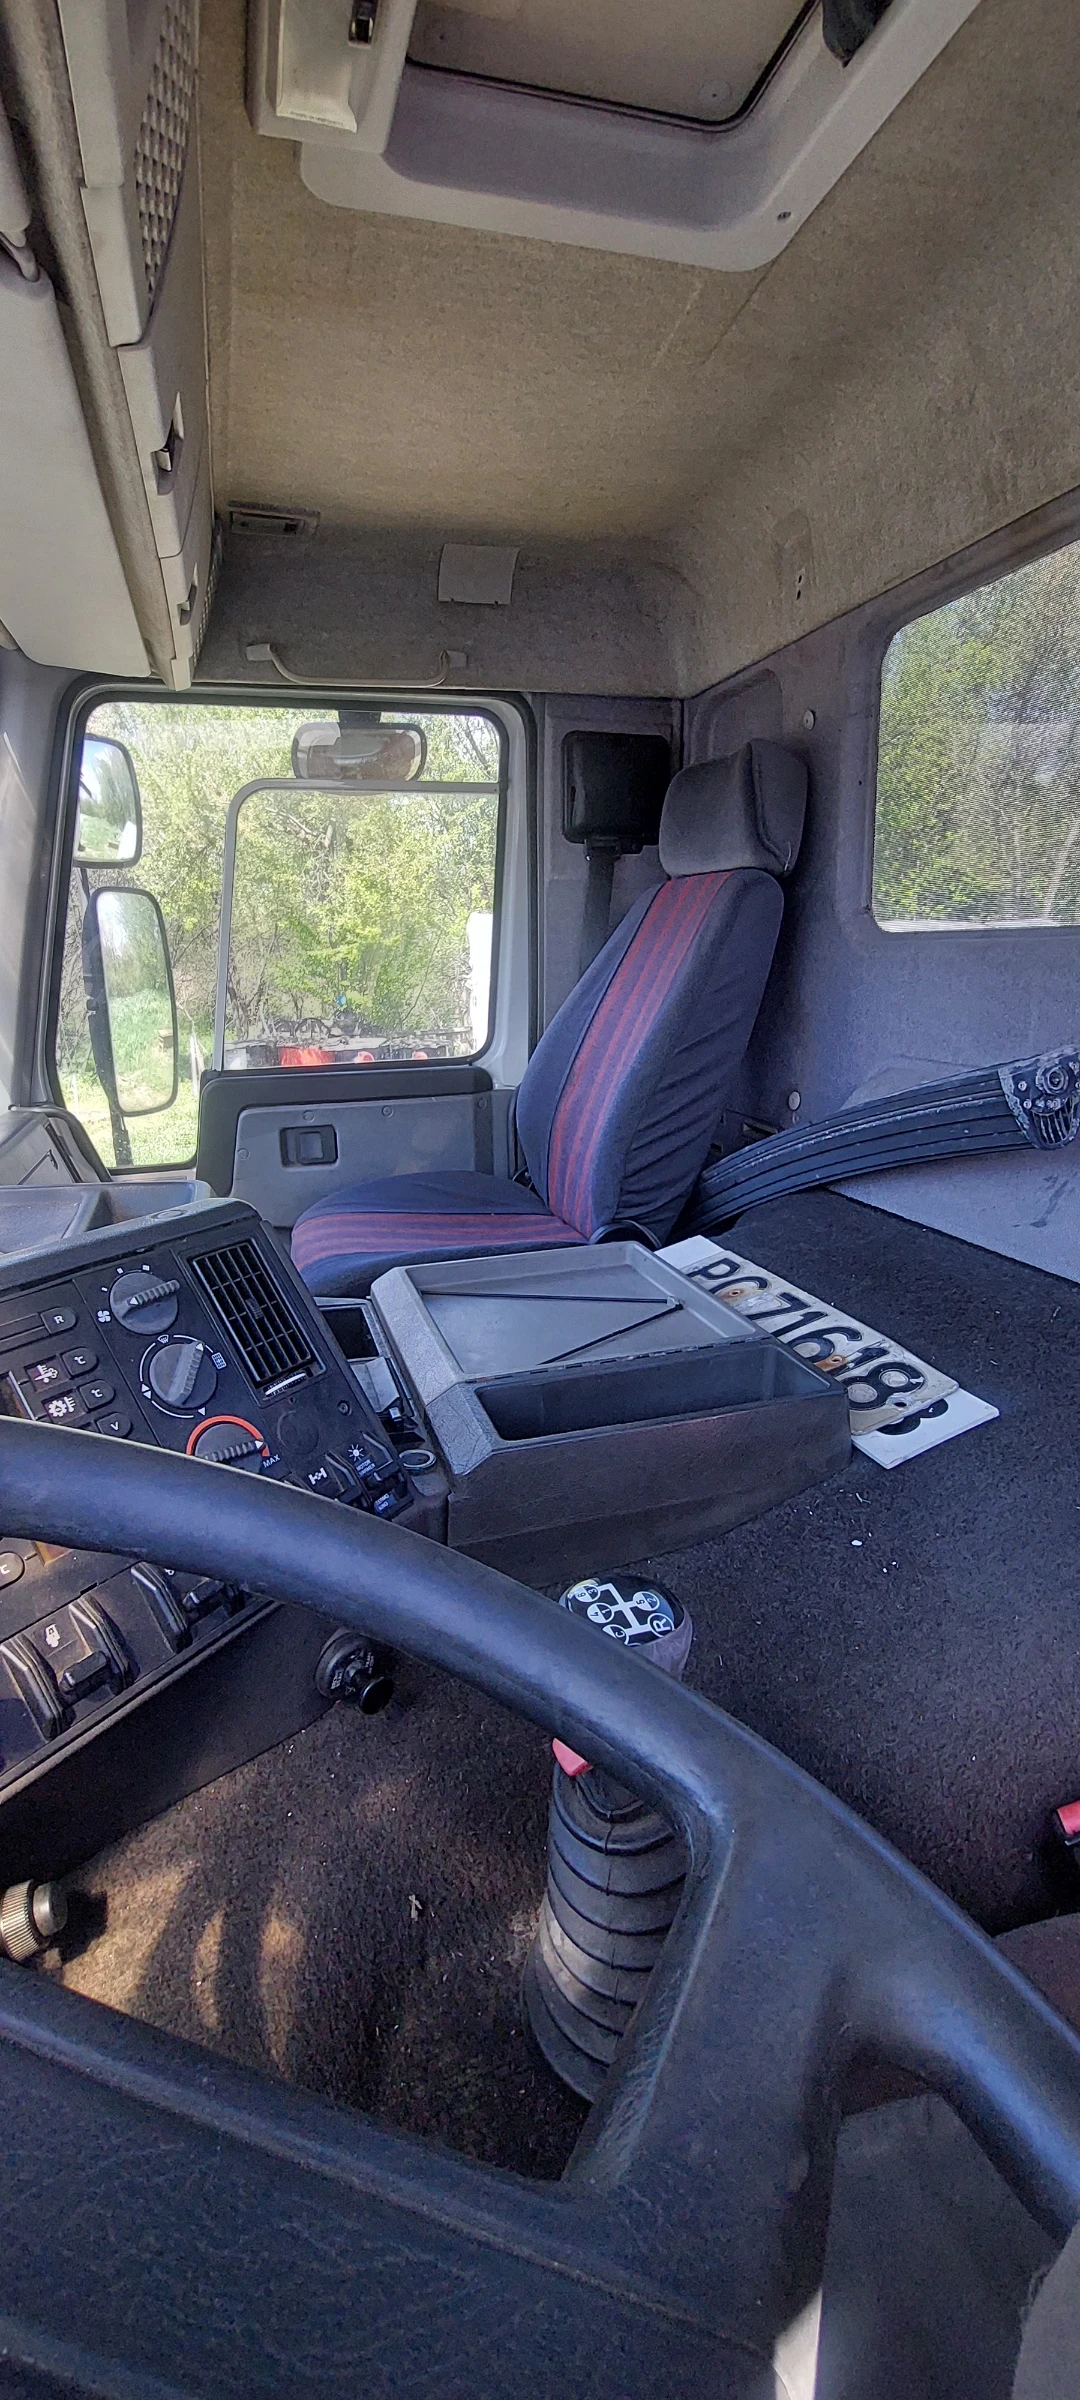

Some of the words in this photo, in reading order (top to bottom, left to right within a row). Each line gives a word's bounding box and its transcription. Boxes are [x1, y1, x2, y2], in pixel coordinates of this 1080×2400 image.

[110, 1421, 119, 1431] V
[262, 1454, 280, 1468] MAX
[653, 1618, 670, 1632] R
